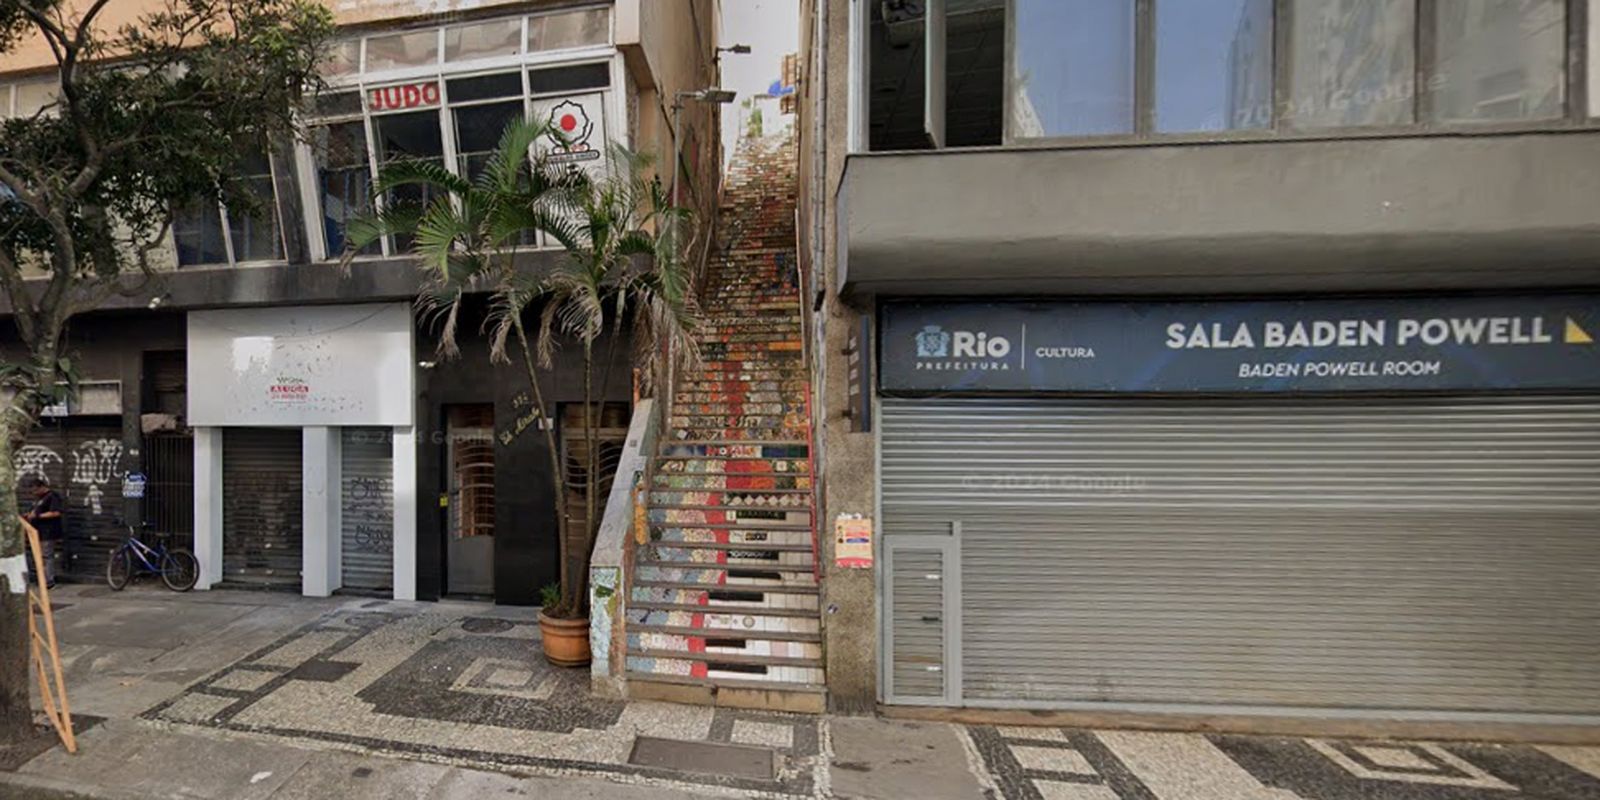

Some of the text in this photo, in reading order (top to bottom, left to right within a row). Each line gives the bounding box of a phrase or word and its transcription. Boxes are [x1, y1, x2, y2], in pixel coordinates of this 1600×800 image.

[369, 83, 440, 110] JUDO
[1165, 317, 1552, 349] SALA BADEN POWELL
[953, 331, 1011, 359] Rio
[1035, 346, 1096, 360] CULTURA
[916, 361, 1009, 371] PREFEITURA
[1238, 360, 1440, 378] BADEN POWELL ROOM
